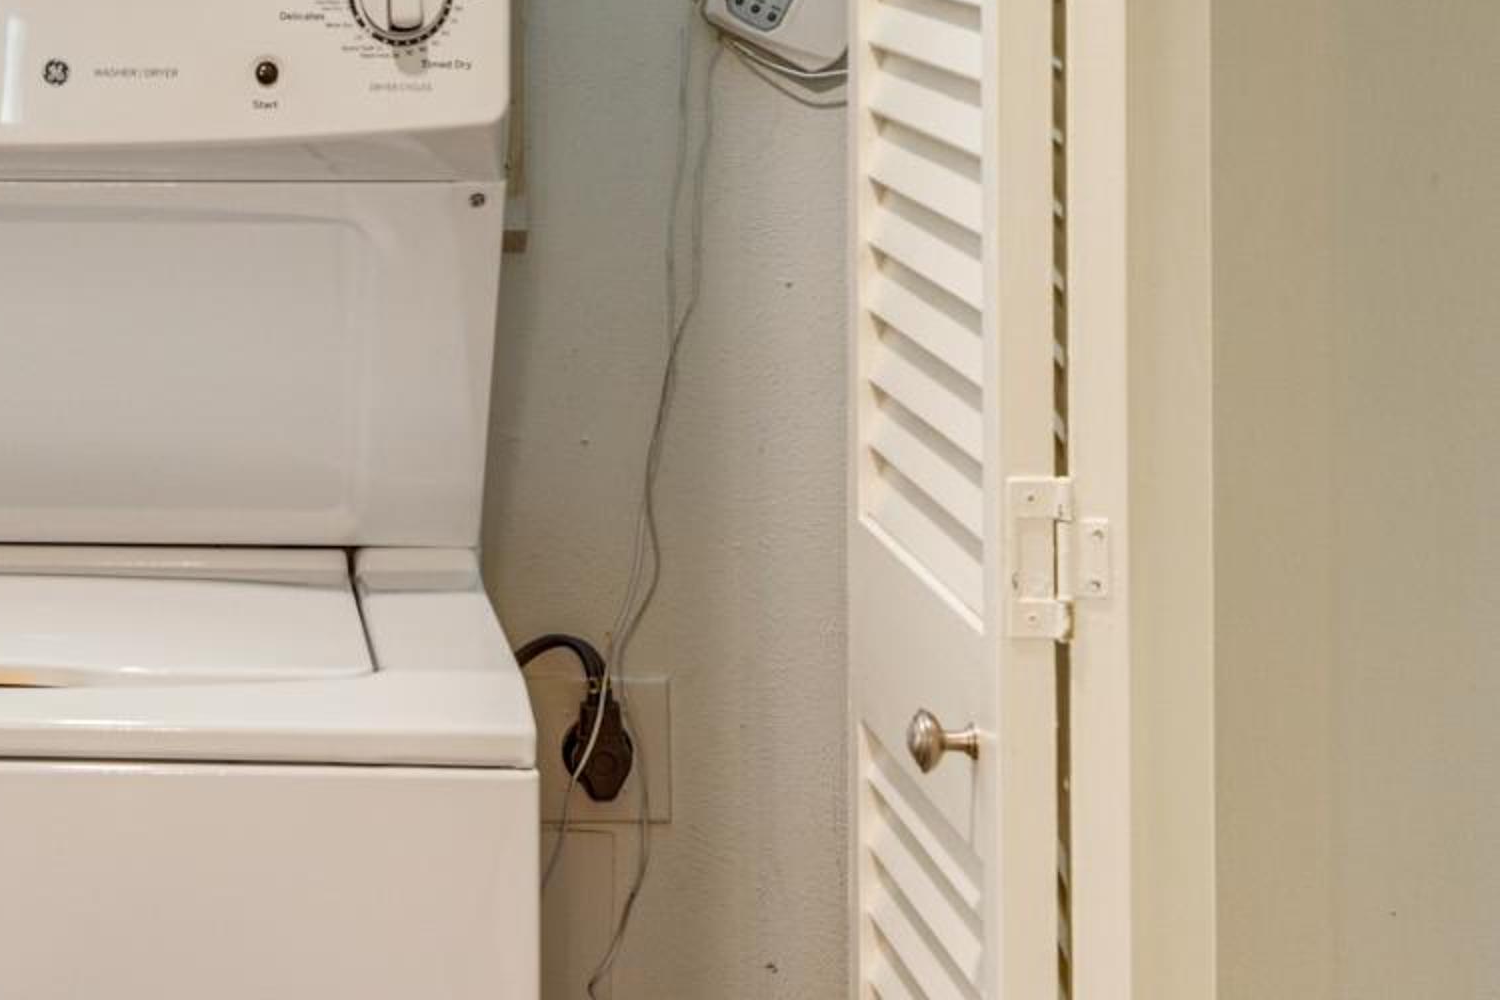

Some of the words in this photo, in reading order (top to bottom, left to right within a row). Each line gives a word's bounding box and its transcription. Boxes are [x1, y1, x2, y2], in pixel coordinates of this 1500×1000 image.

[280, 12, 325, 21] Delicates
[454, 60, 472, 70] Dry
[252, 100, 278, 109] Start
